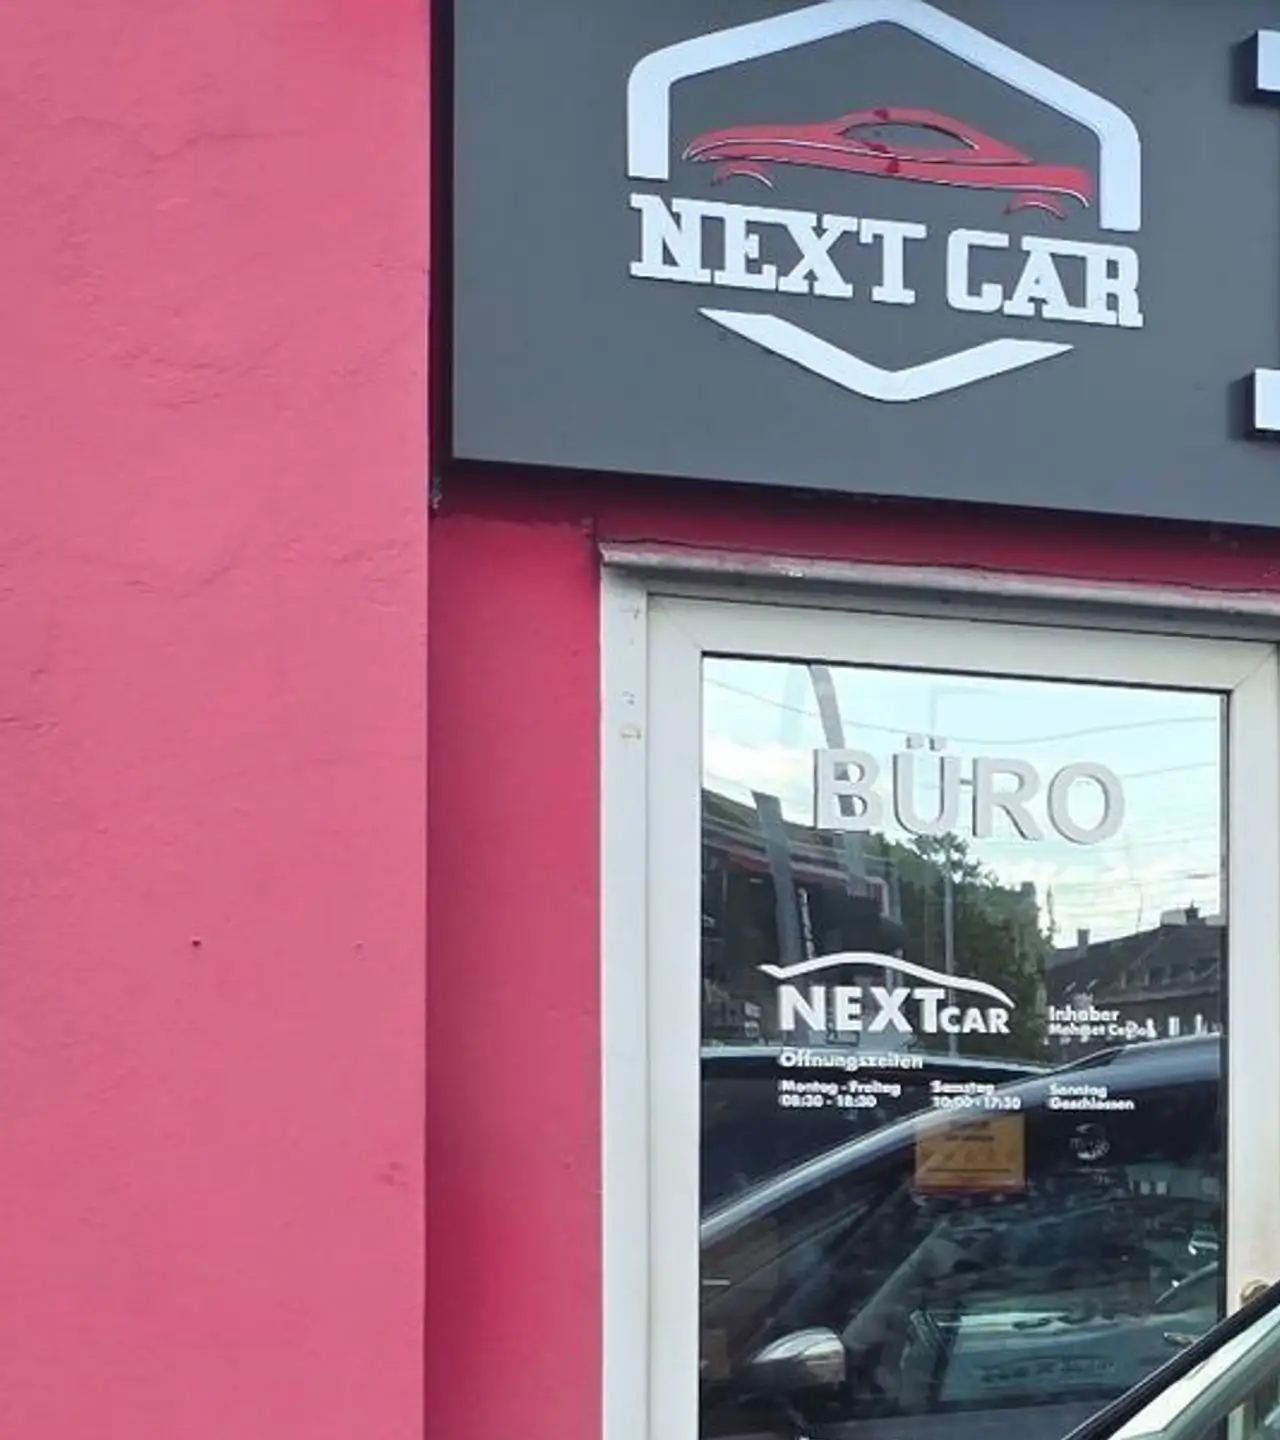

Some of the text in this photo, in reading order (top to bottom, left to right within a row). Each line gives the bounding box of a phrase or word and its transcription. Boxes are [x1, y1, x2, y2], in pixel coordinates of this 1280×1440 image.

[628, 193, 1144, 327] NEXT CAR
[813, 734, 1126, 846] BÜRO
[1049, 1005, 1120, 1022] Inhaber
